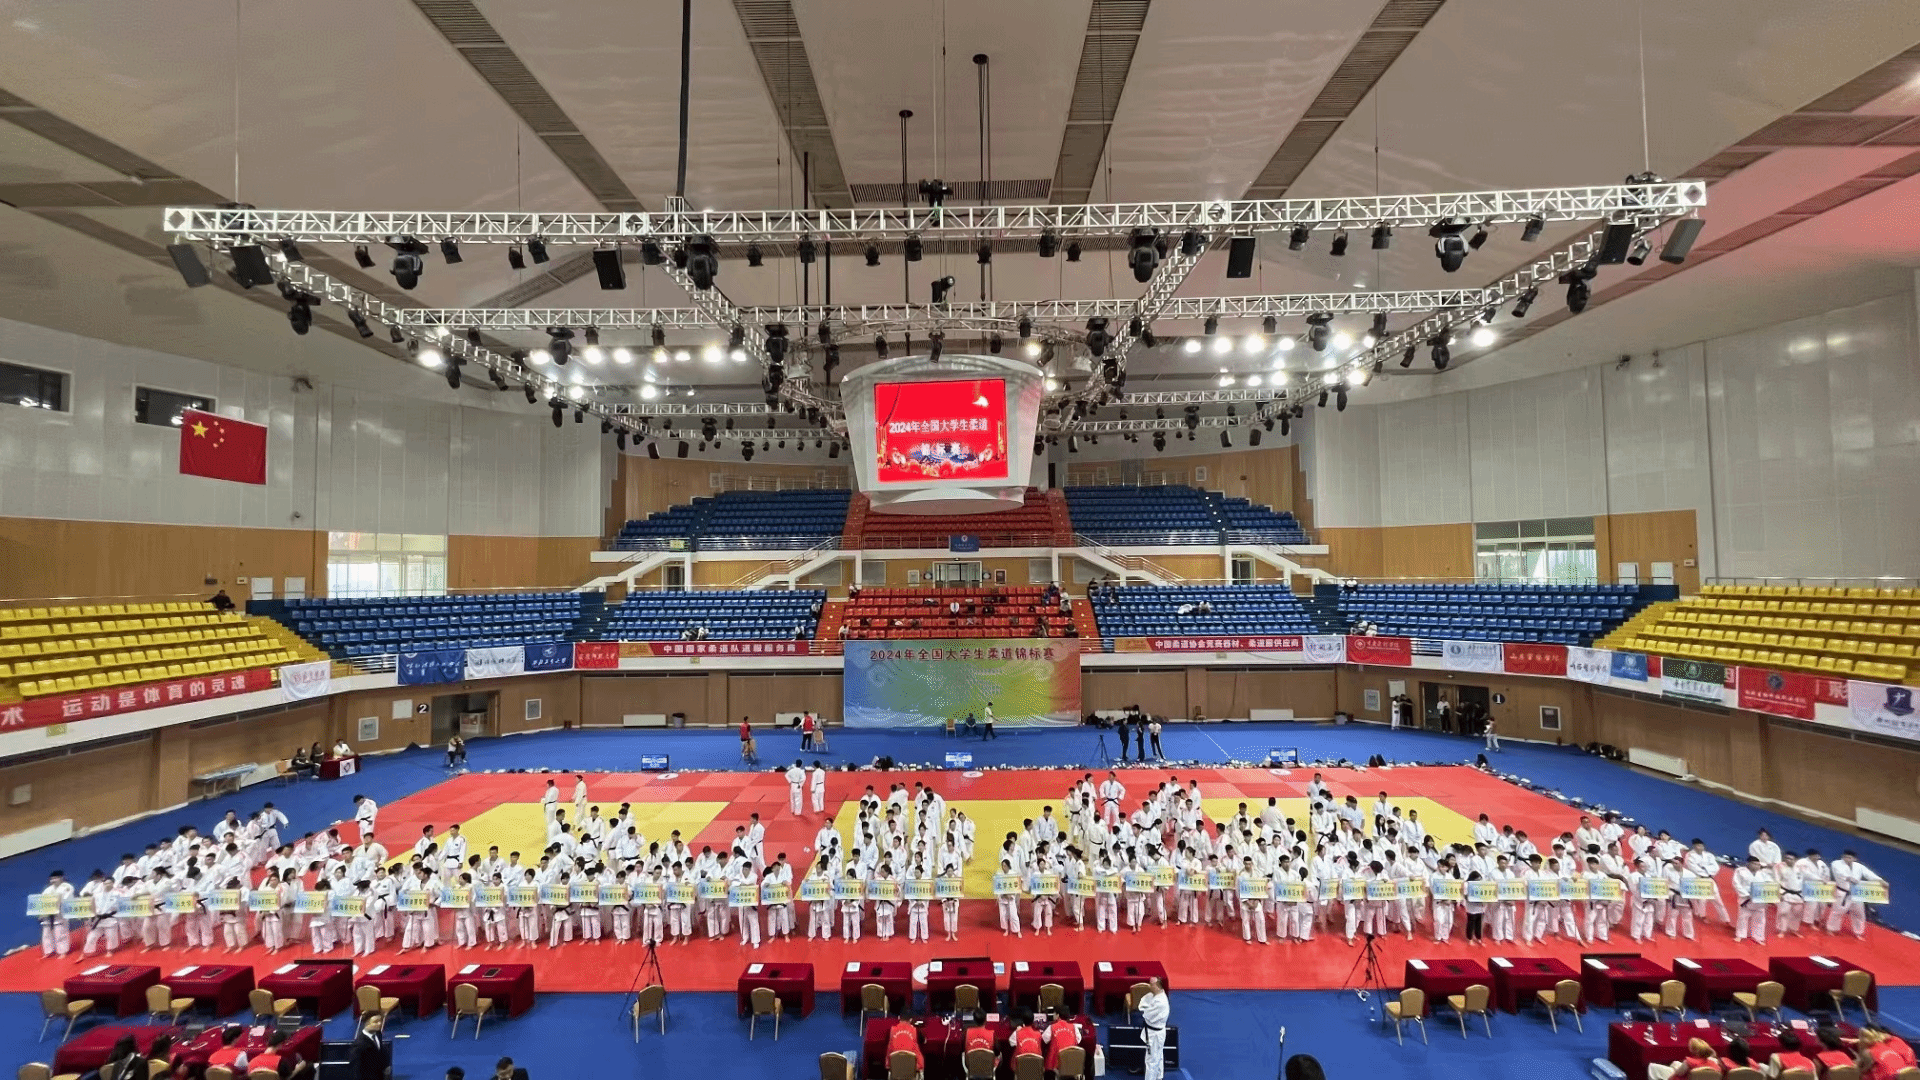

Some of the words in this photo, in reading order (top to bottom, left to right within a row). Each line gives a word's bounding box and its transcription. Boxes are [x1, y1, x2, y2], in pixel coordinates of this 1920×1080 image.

[889, 418, 988, 433] 2024年全国大学生柔道
[870, 646, 1055, 661] 2024年全国大学生柔道锦标赛
[62, 674, 247, 718] 运动是体育的灵魂
[1495, 693, 1502, 704] 1
[419, 703, 428, 714] 2
